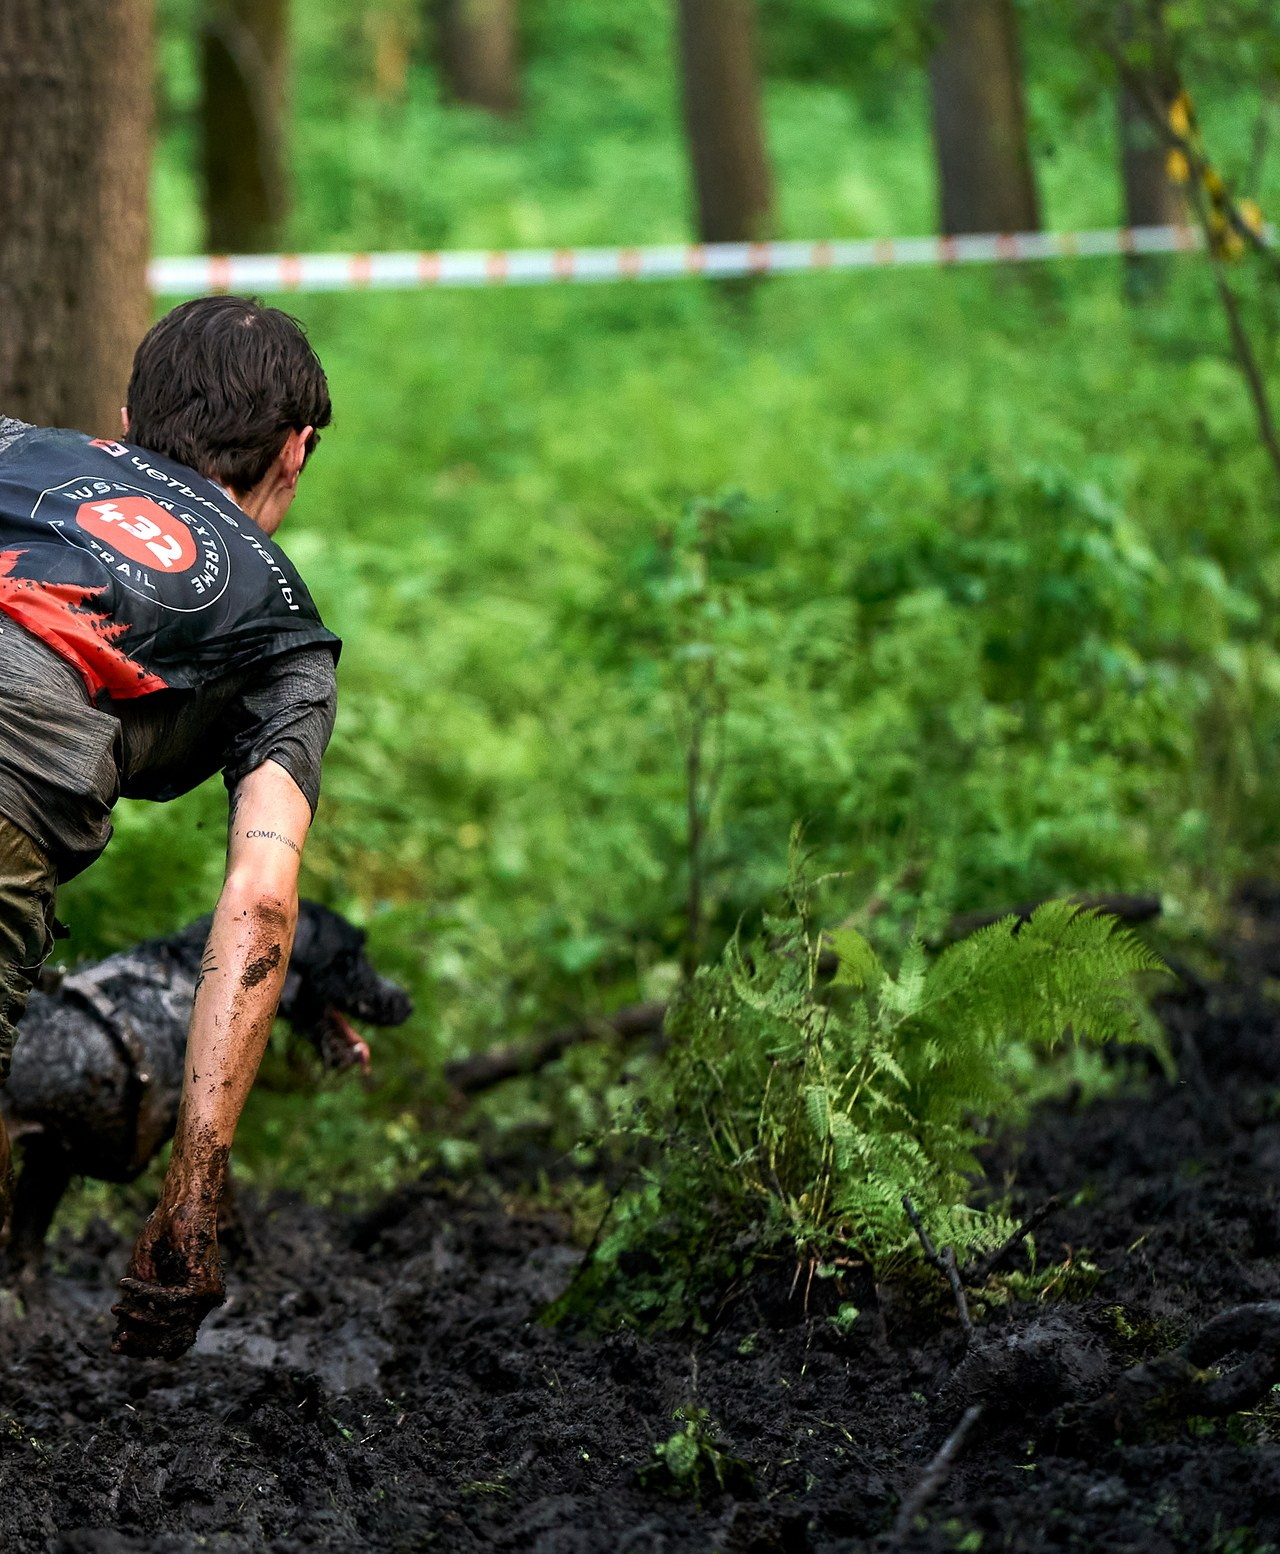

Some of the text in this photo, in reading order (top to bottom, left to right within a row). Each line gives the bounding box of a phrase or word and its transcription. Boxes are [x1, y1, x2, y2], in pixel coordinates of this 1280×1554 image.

[90, 503, 182, 568] 432
[90, 540, 155, 589] TRAIL
[180, 513, 219, 594] EXTREME
